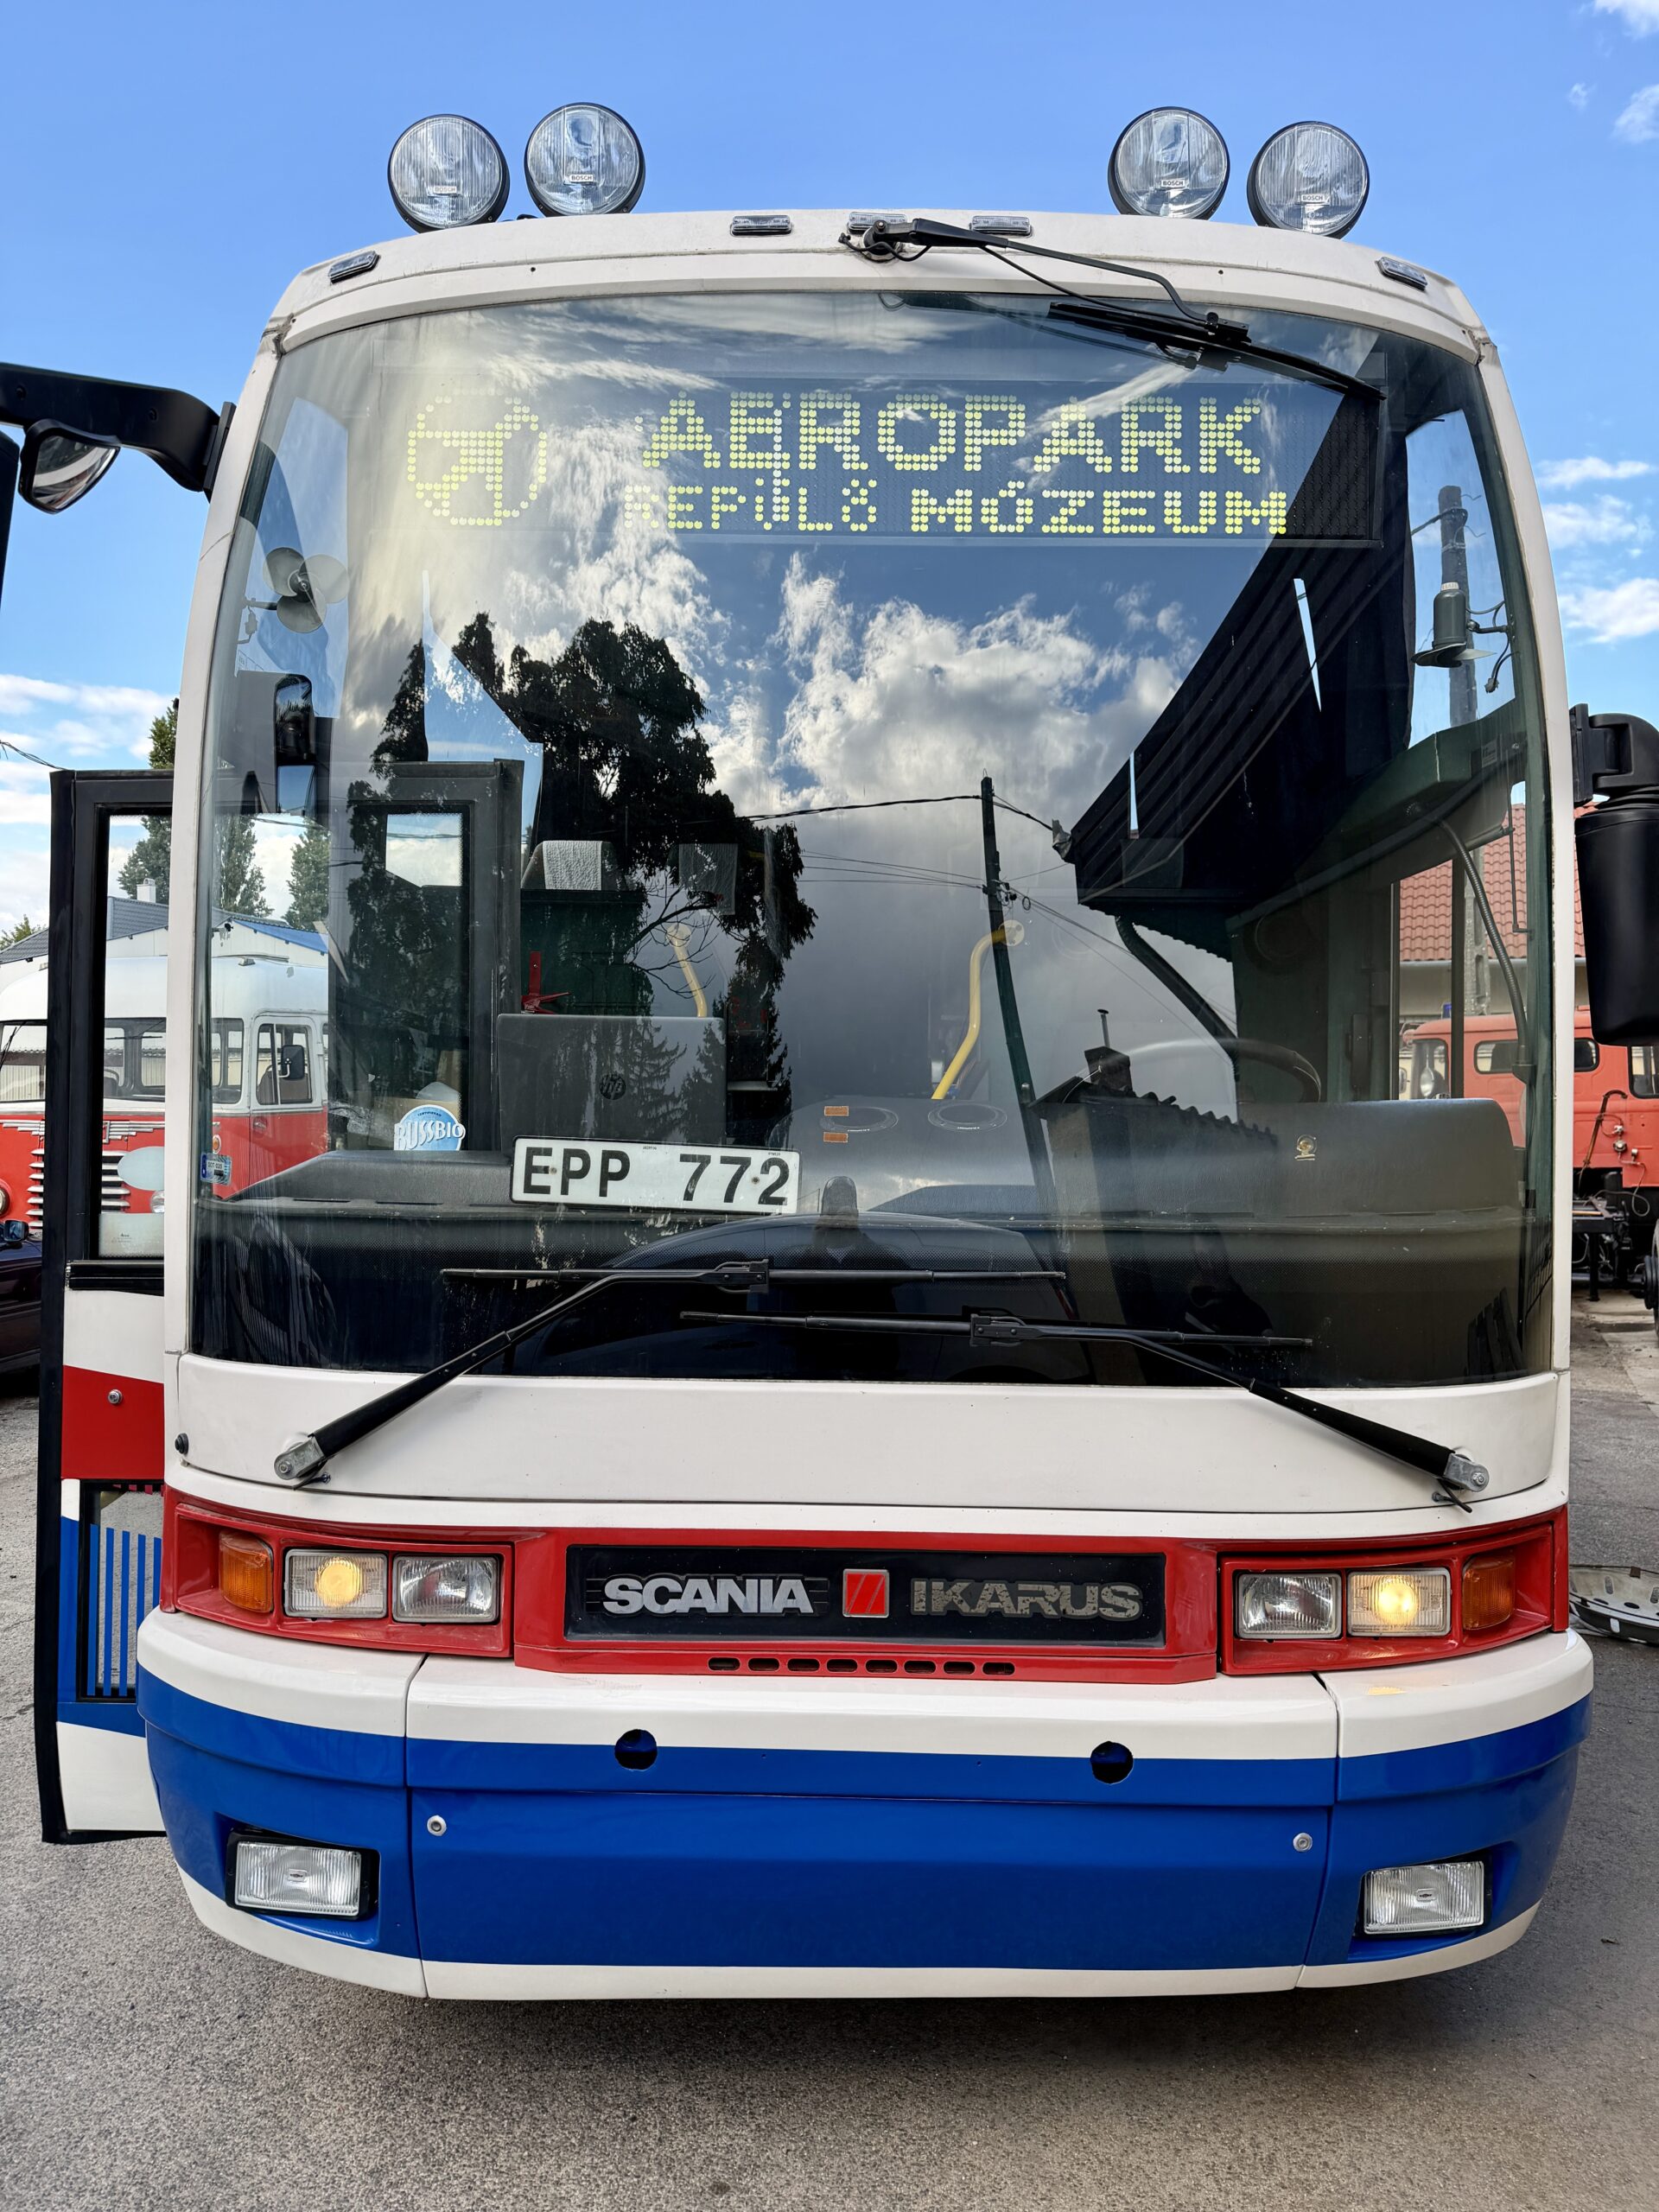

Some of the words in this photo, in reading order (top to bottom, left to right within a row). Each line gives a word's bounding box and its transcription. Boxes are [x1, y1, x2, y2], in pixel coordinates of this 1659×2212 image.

[642, 391, 1261, 473] AEROPARK
[394, 1120, 465, 1150] BUSSBIO
[523, 1147, 631, 1198] EPP
[679, 1153, 790, 1206] 772
[602, 1577, 814, 1614] SCANIA
[912, 1580, 1141, 1618] IKARUS
